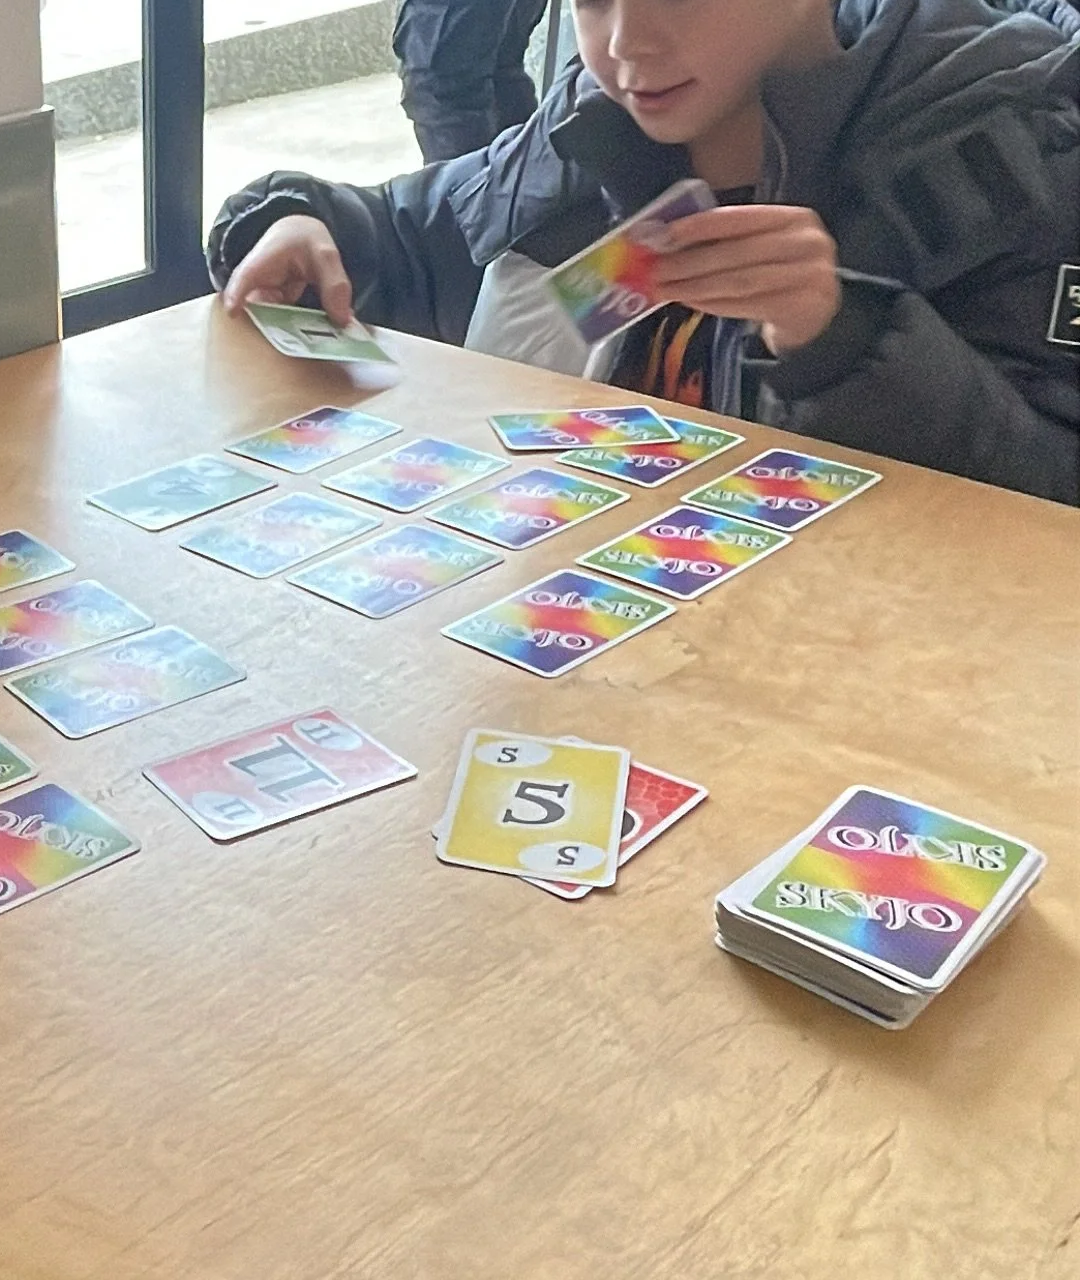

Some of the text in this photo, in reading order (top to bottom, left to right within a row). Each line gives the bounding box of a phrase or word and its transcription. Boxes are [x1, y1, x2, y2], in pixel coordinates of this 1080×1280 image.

[497, 747, 518, 763] 5
[502, 781, 569, 825] 5
[827, 825, 1006, 871] SKYJO
[776, 881, 962, 932] SKYJO
